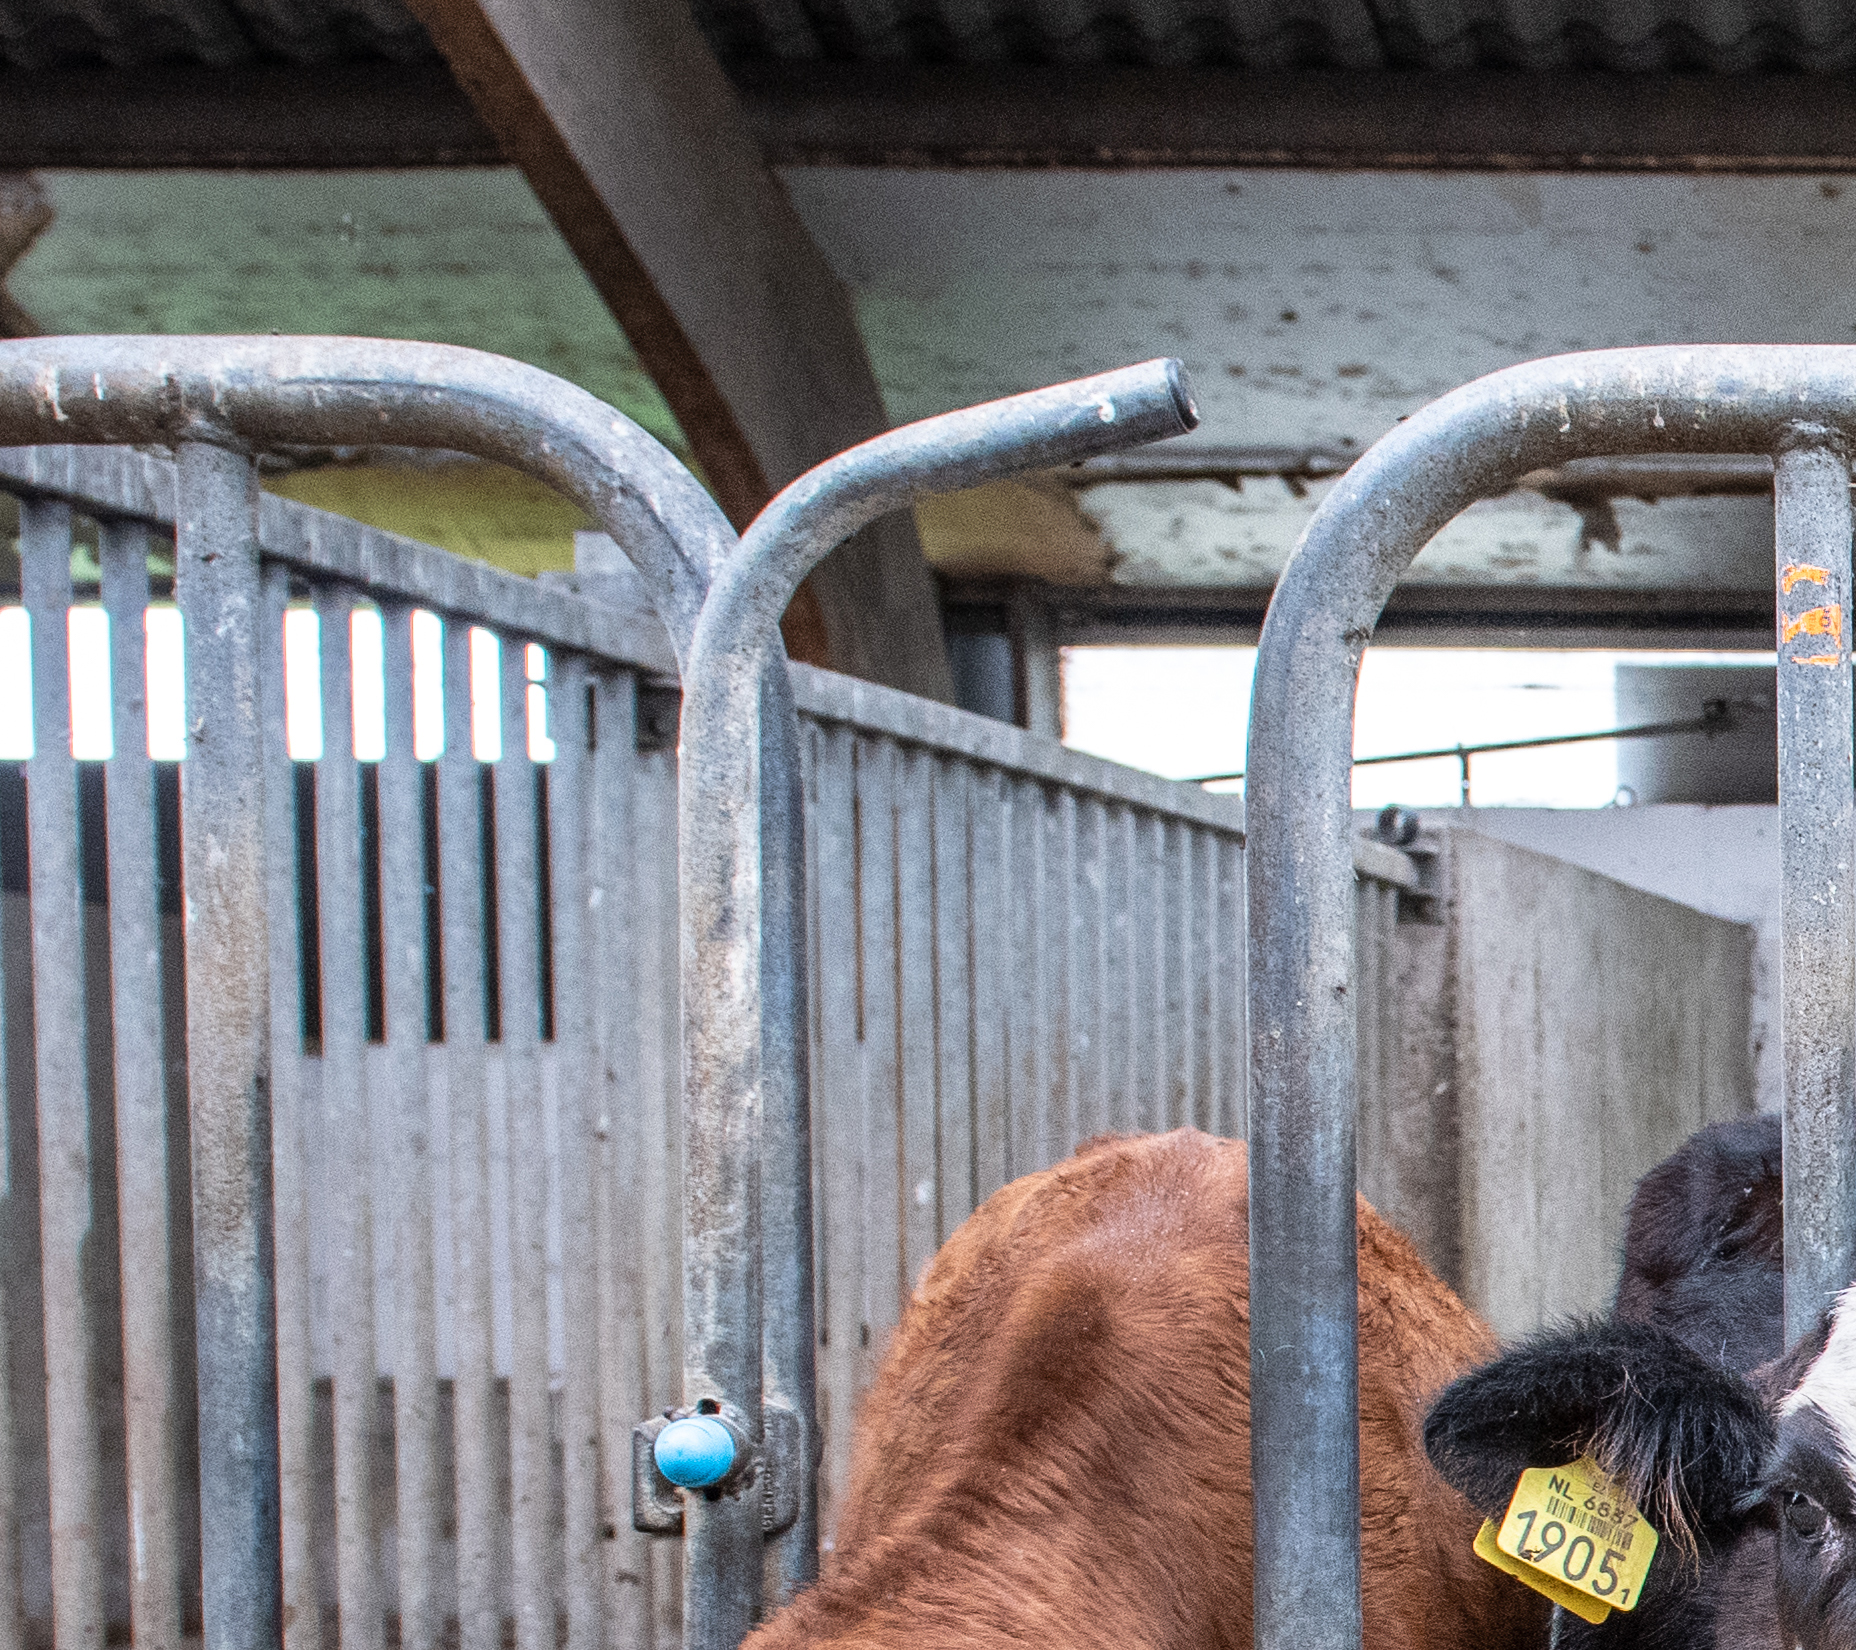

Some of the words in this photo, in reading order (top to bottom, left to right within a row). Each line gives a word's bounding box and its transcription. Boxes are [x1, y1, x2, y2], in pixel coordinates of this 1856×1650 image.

[1547, 1474, 1574, 1501] NL
[1516, 1509, 1627, 1597] 1905
[1621, 1588, 1631, 1605] 1
